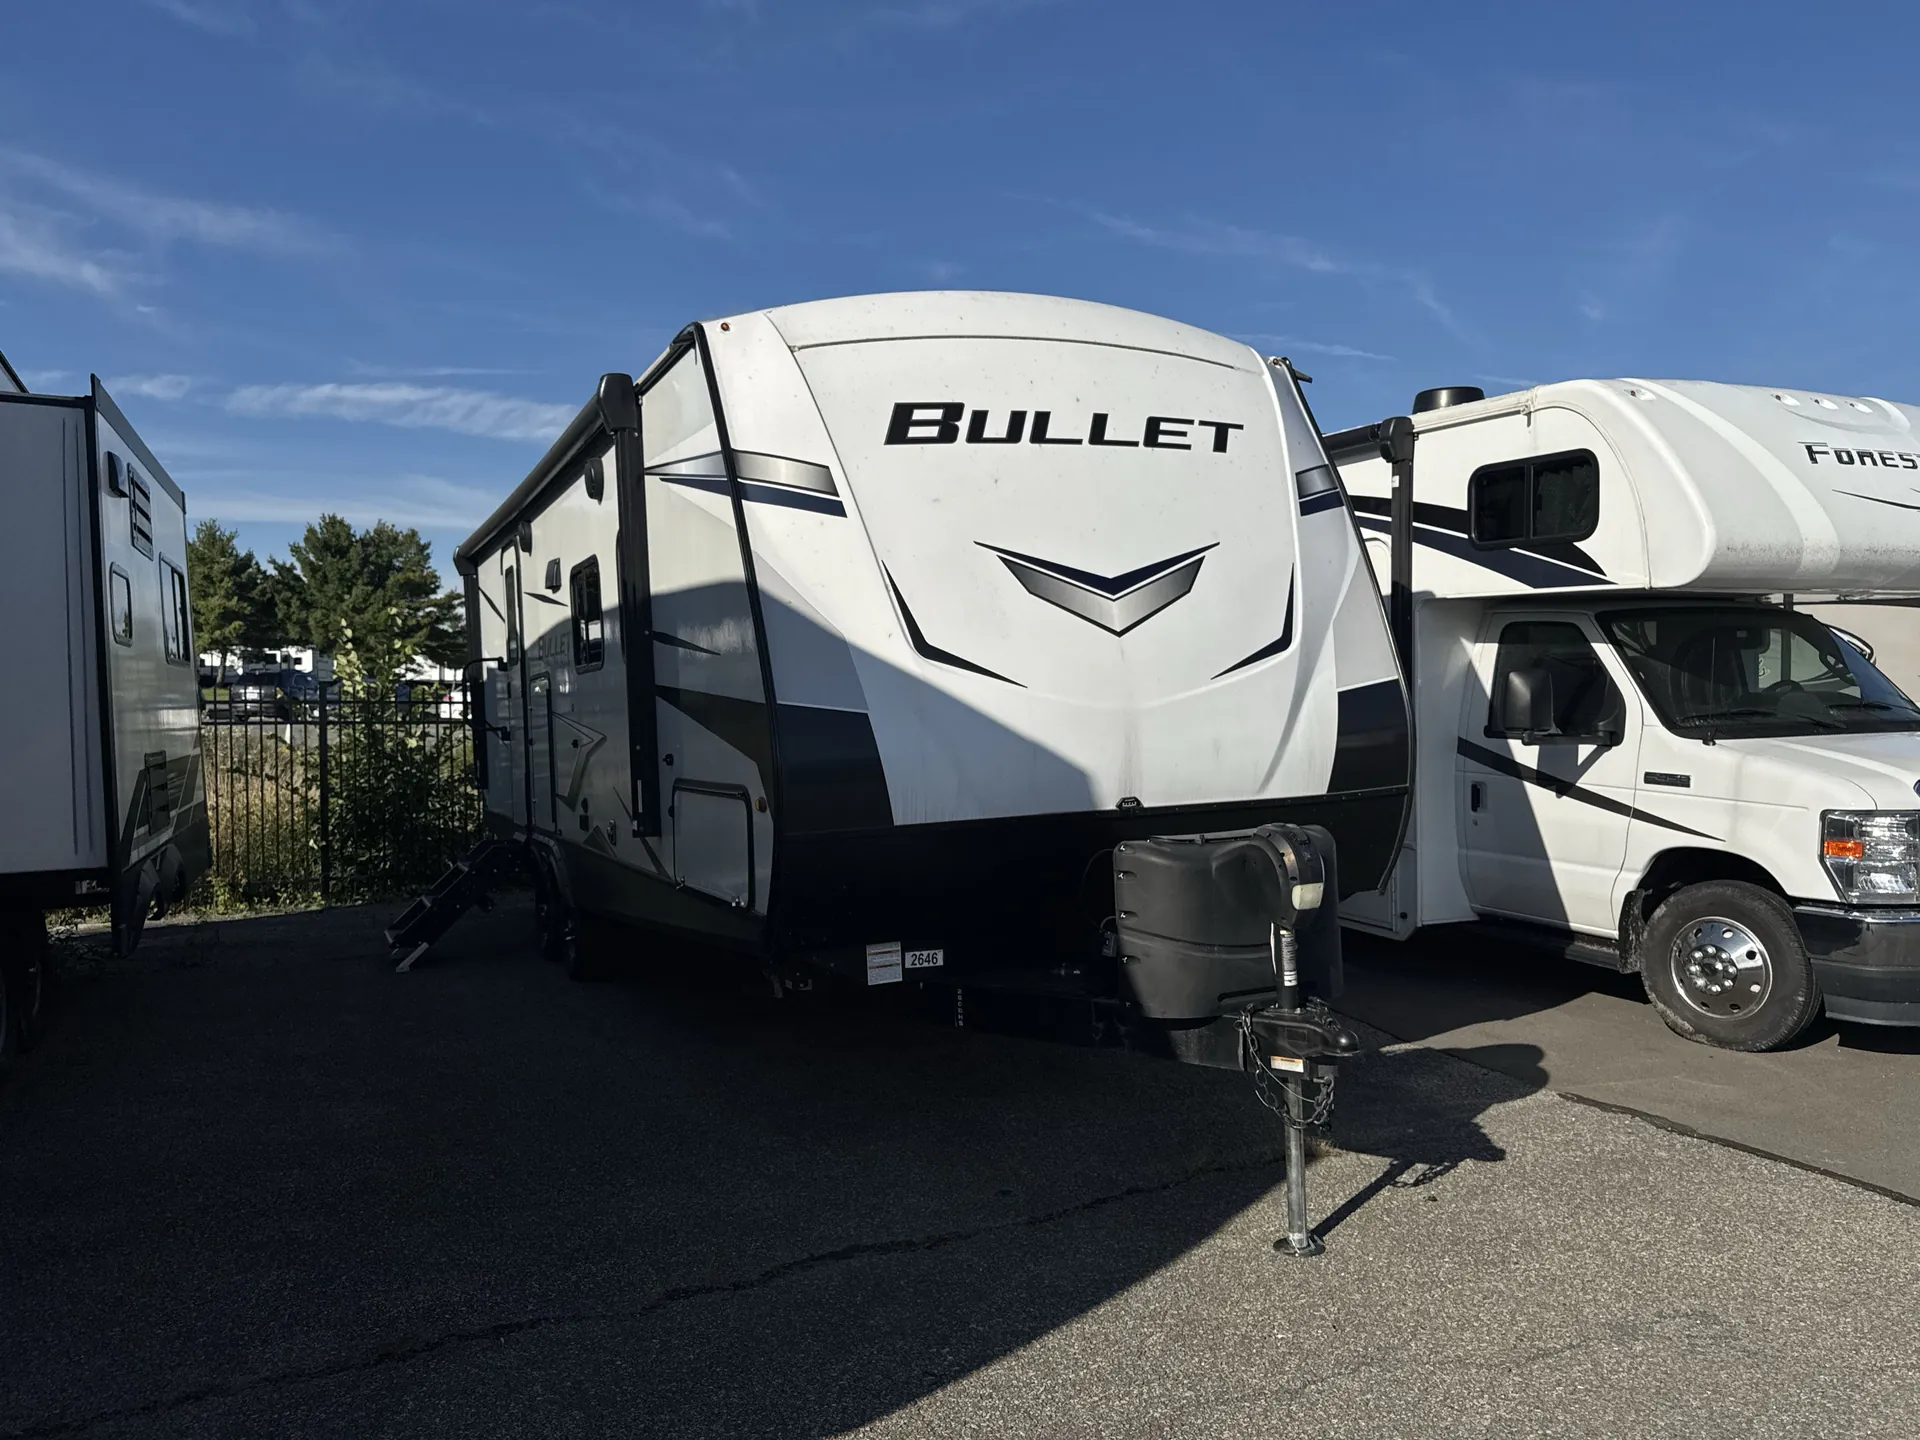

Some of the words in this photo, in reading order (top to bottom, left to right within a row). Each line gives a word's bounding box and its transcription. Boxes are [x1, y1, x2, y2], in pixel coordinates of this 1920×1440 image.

[884, 402, 1244, 454] BULLET
[1798, 441, 1920, 469] FORES
[910, 952, 938, 967] 2646
